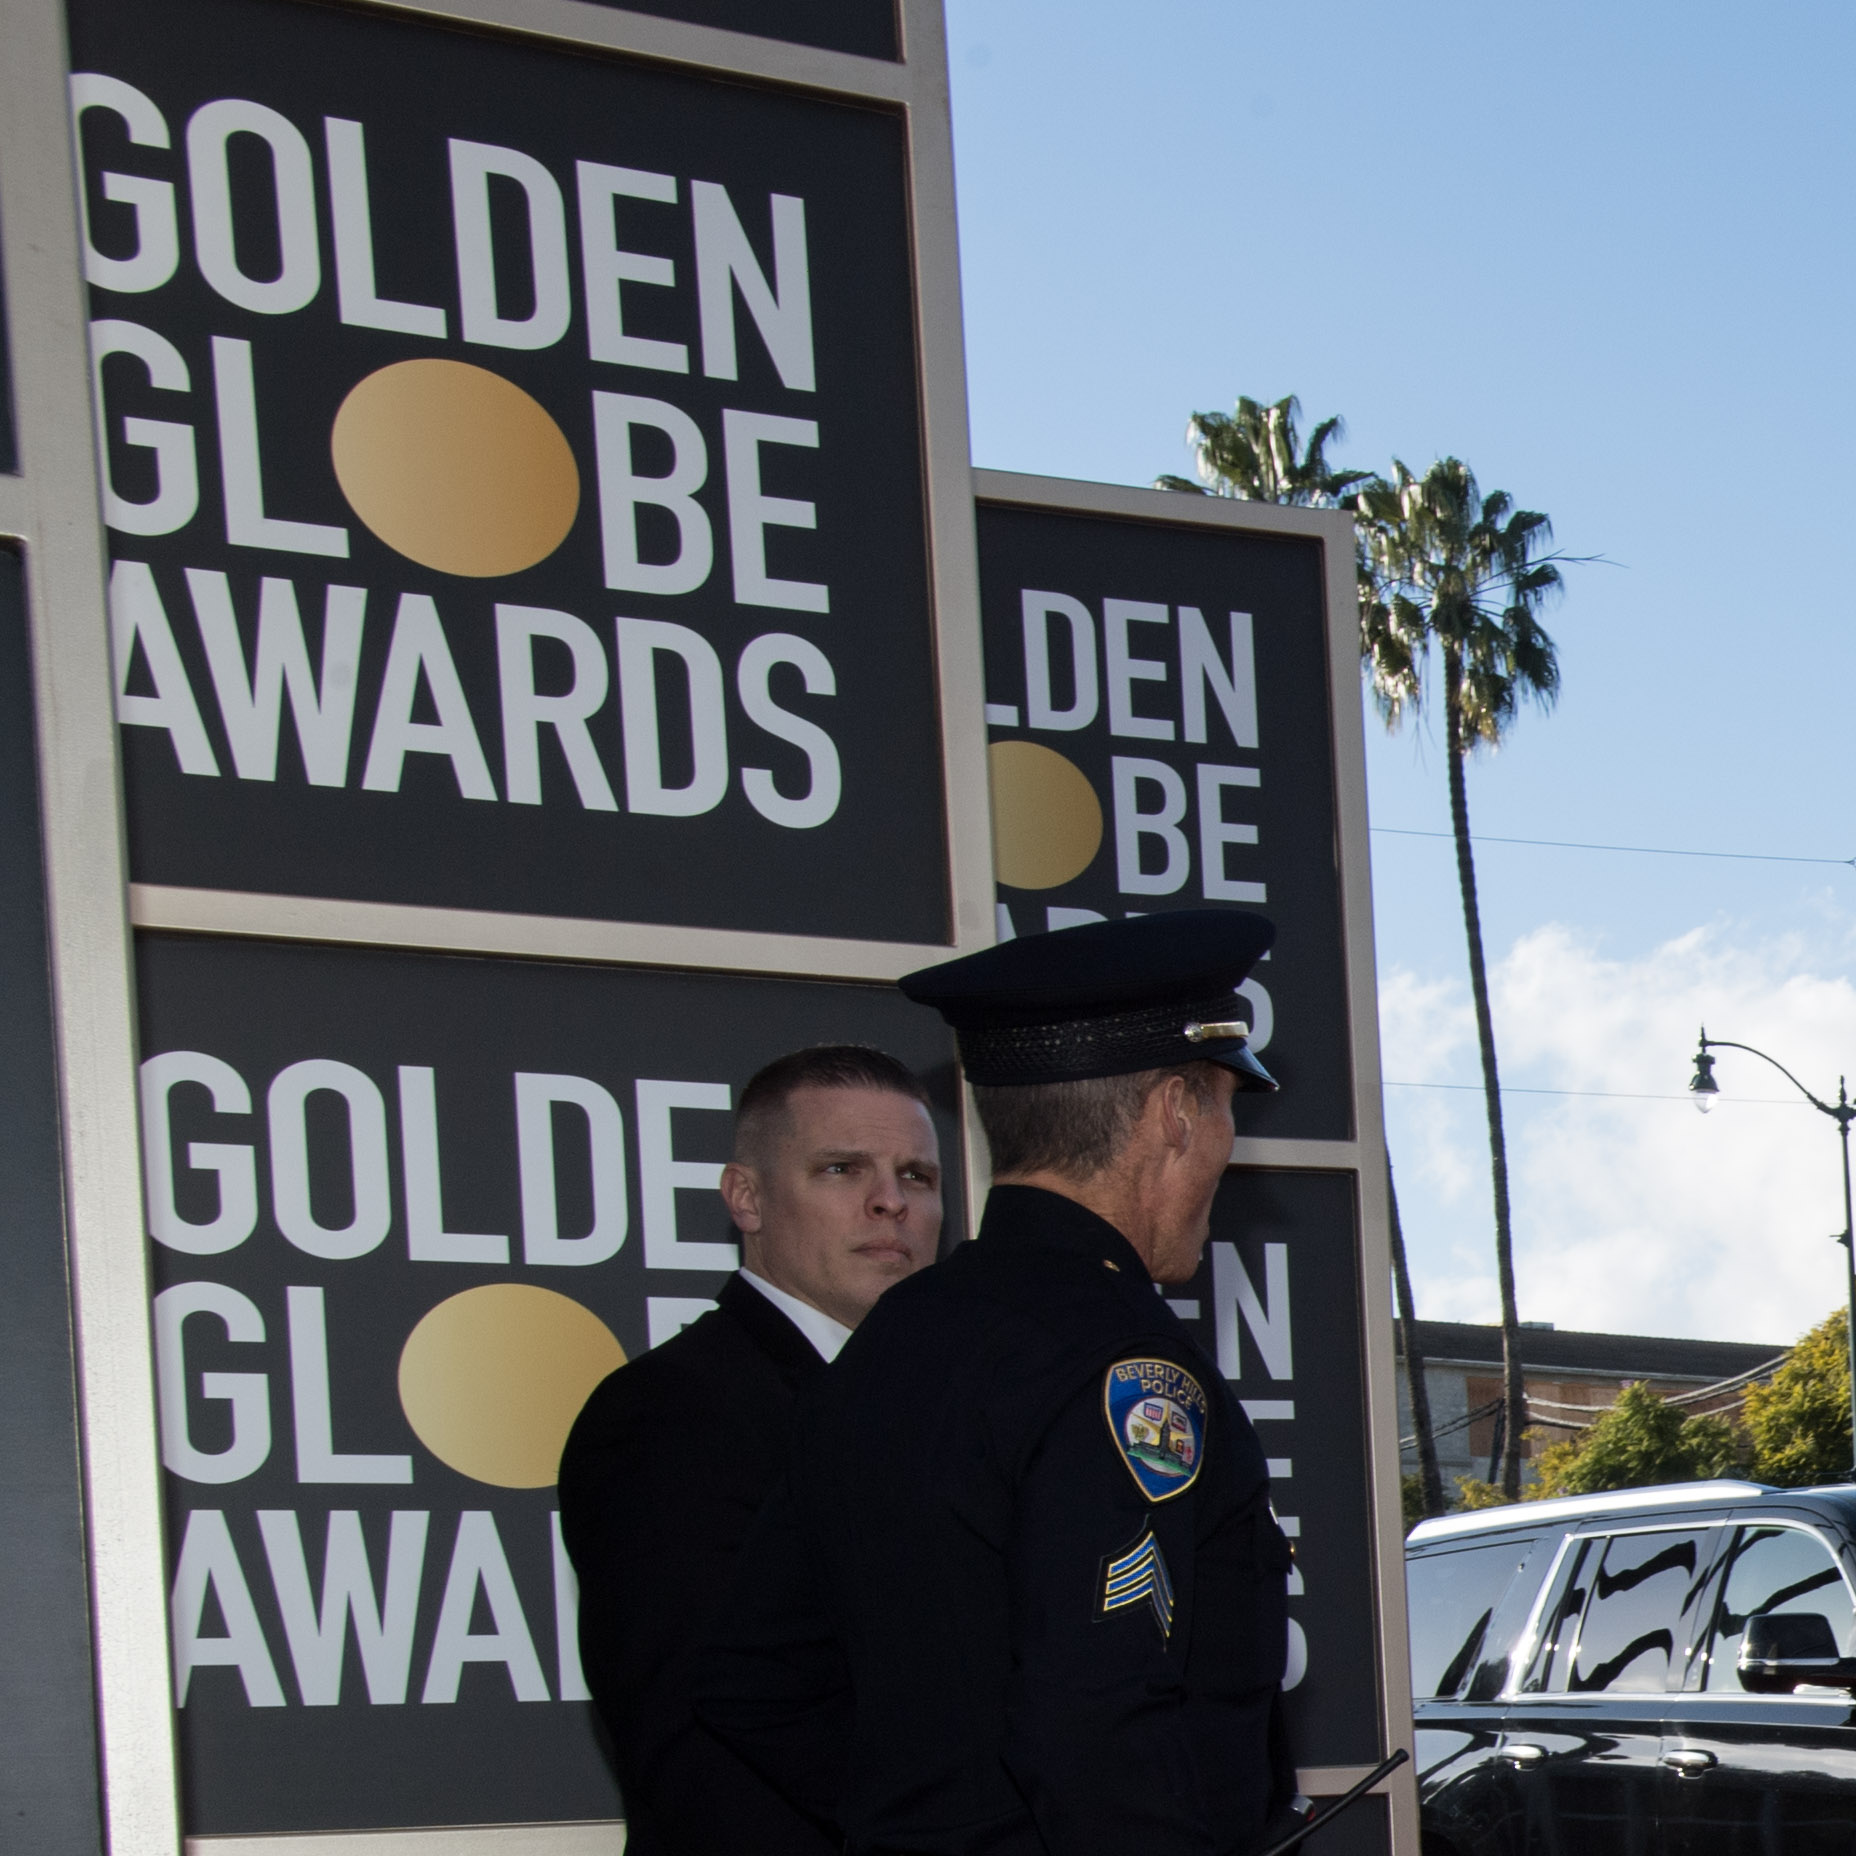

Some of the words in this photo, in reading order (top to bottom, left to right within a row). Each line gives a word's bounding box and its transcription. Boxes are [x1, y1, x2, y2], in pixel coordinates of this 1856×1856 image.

[70, 73, 816, 392] GOLDEN
[108, 559, 841, 828] AWARDS
[1115, 1363, 1180, 1383] BEVERLY
[1141, 1379, 1193, 1410] POLICE
